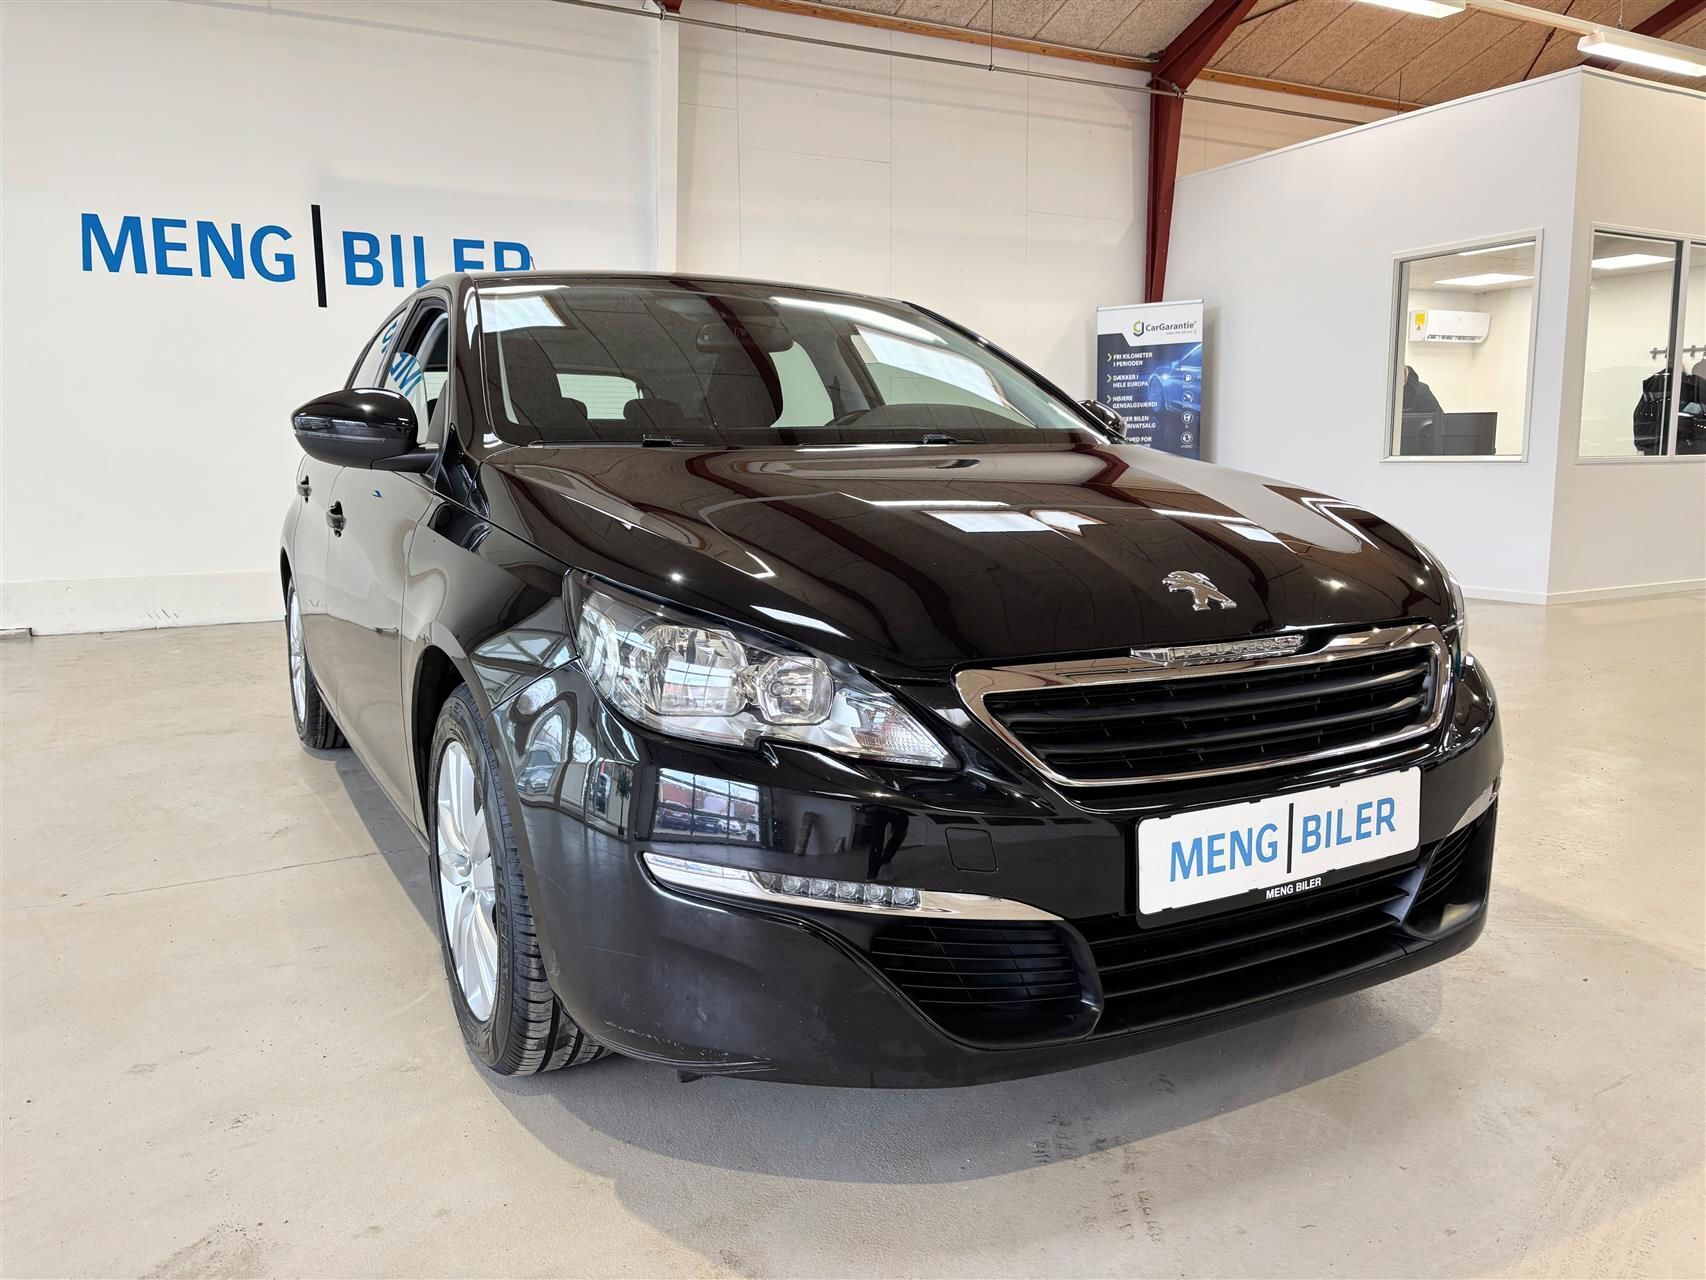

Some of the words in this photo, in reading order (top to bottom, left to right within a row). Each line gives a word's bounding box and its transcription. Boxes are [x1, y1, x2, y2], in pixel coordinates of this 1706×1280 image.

[81, 213, 296, 283] MENG
[1145, 320, 1194, 332] CarGarantie
[1122, 352, 1153, 360] KILOMETER
[1127, 380, 1149, 388] EUROPA
[1170, 823, 1278, 882] MENG
[1301, 797, 1396, 854] BILER
[1266, 884, 1294, 900] MENG
[1295, 877, 1322, 892] BILER
